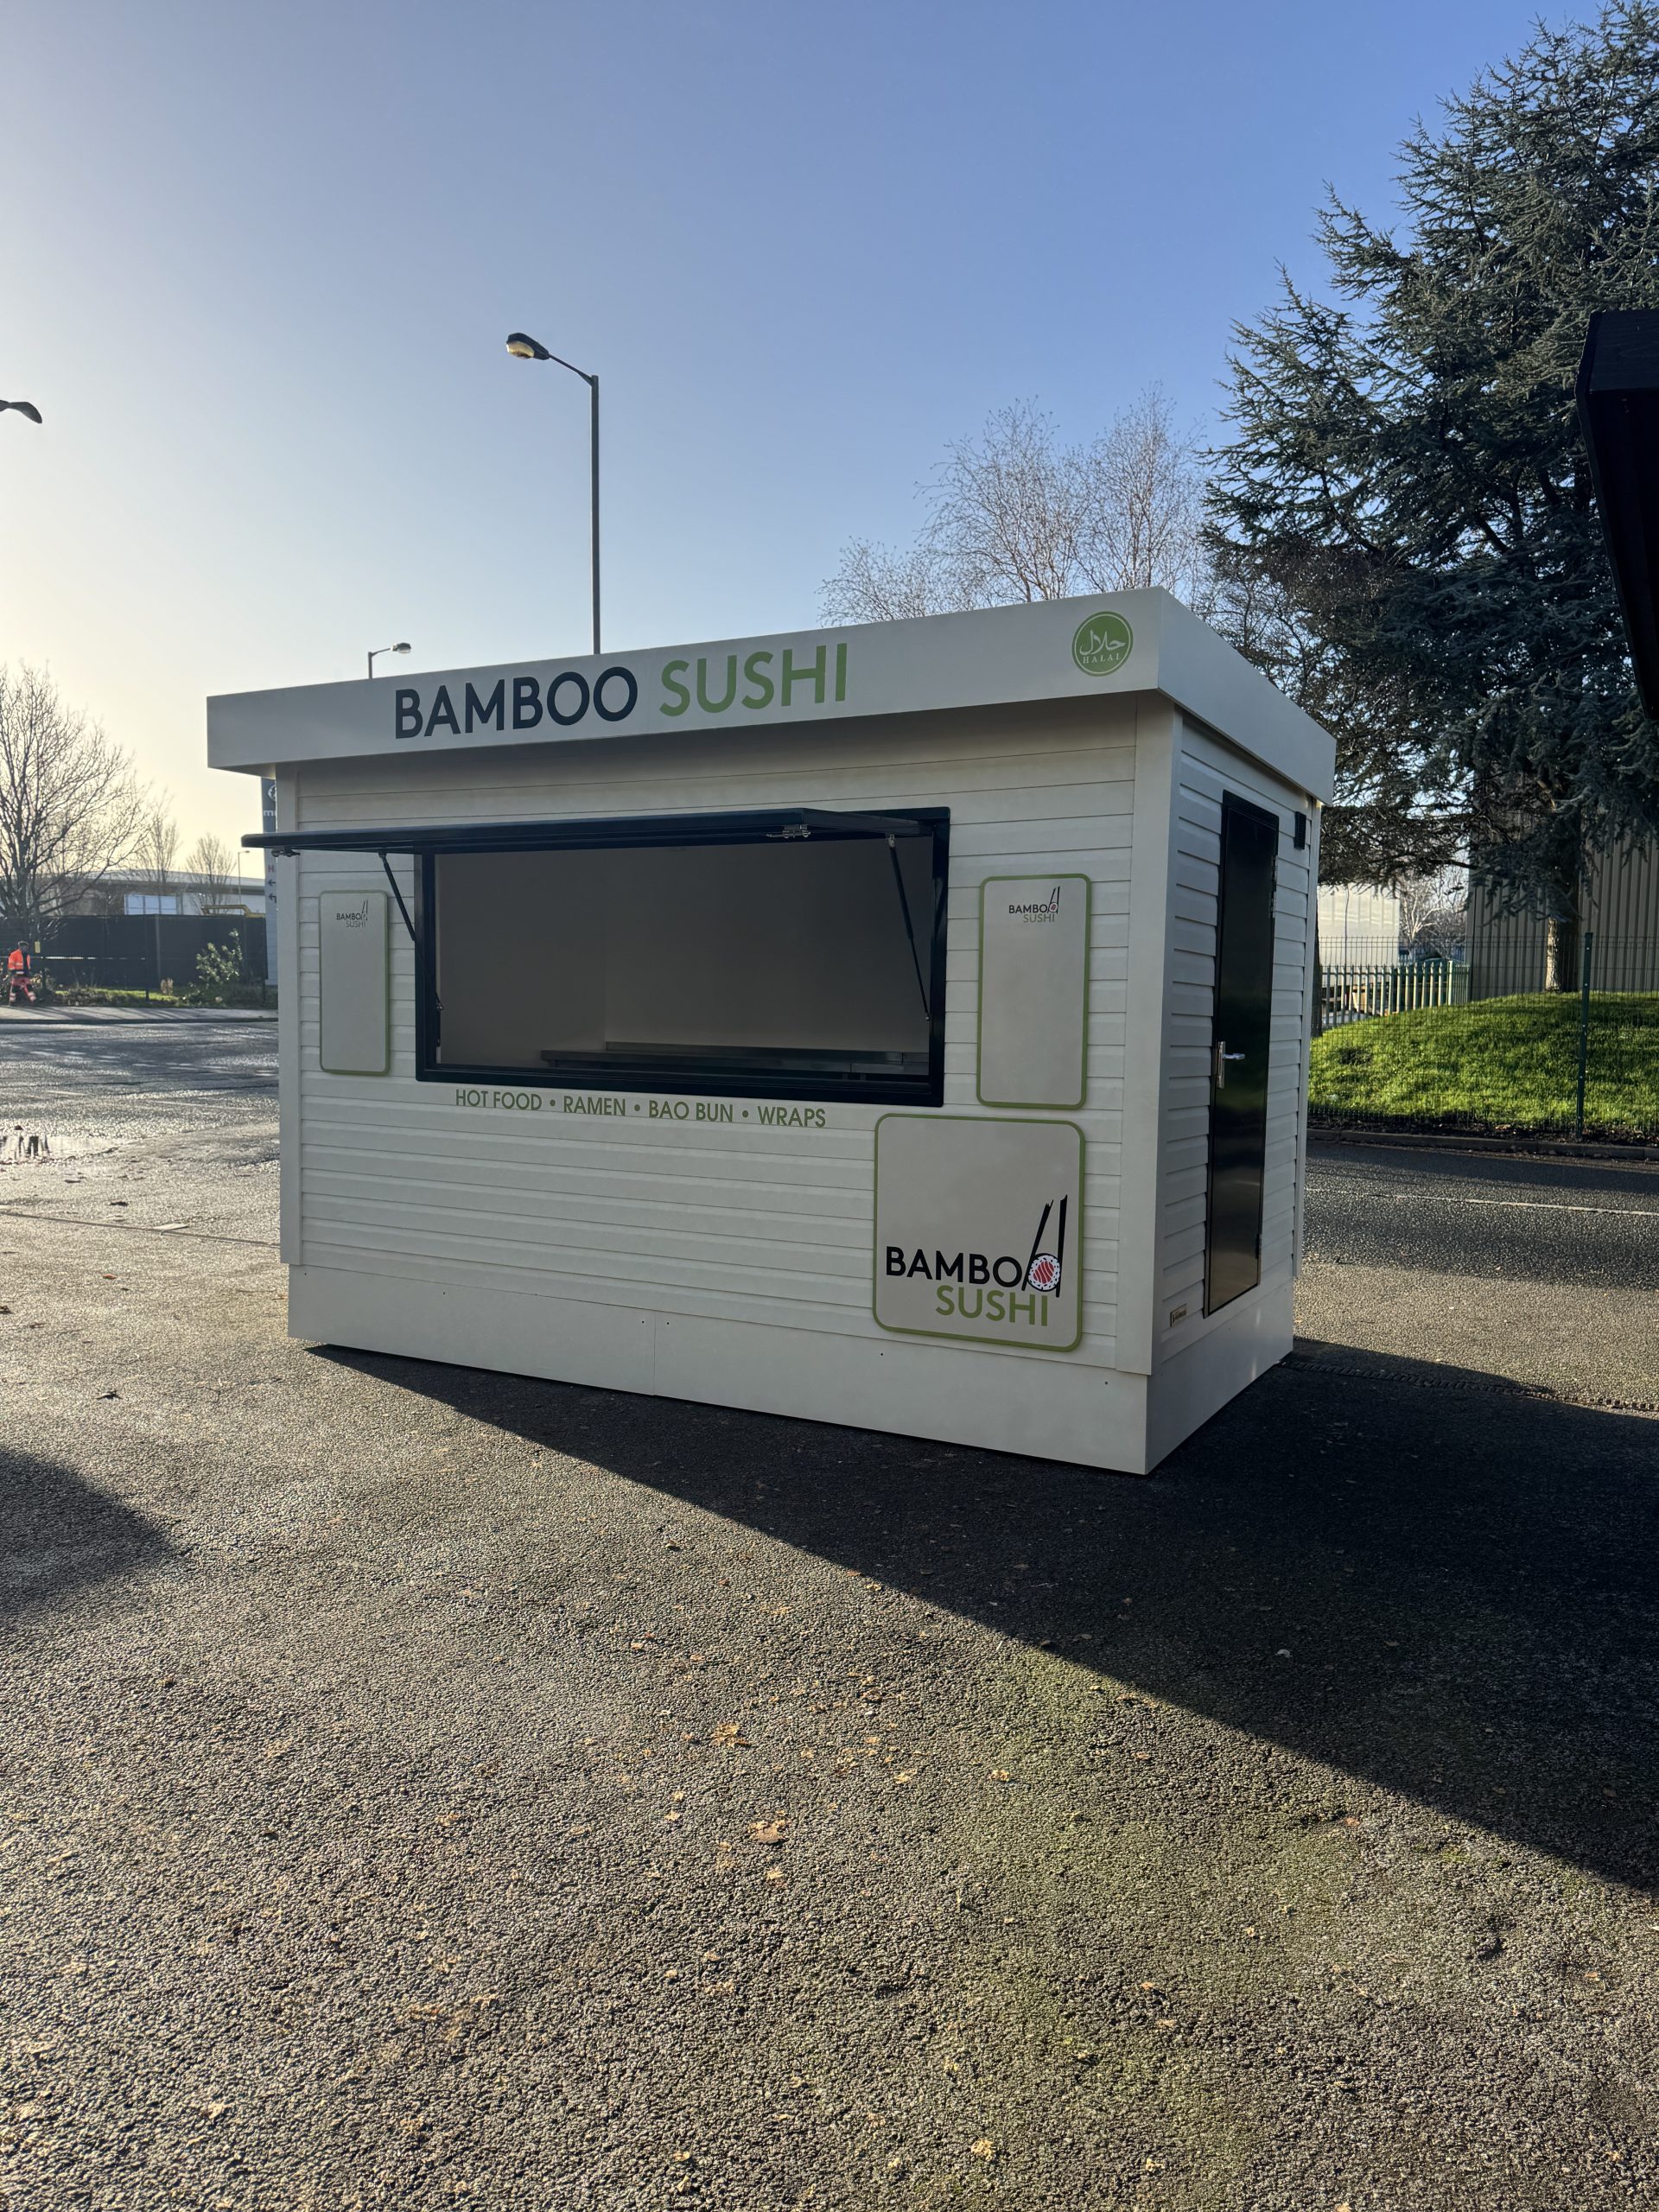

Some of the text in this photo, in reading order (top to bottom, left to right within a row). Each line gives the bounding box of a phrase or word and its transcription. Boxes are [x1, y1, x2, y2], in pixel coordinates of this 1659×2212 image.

[1079, 629, 1126, 656] حلال
[1083, 652, 1121, 664] HALAL
[395, 643, 848, 739] BAMBOO SUSHI
[1023, 913, 1055, 924] SUSHI
[455, 1089, 826, 1128] HOT FOOD RAMEN BAO BUN WRAPS
[936, 1285, 1047, 1327] SUSHI
